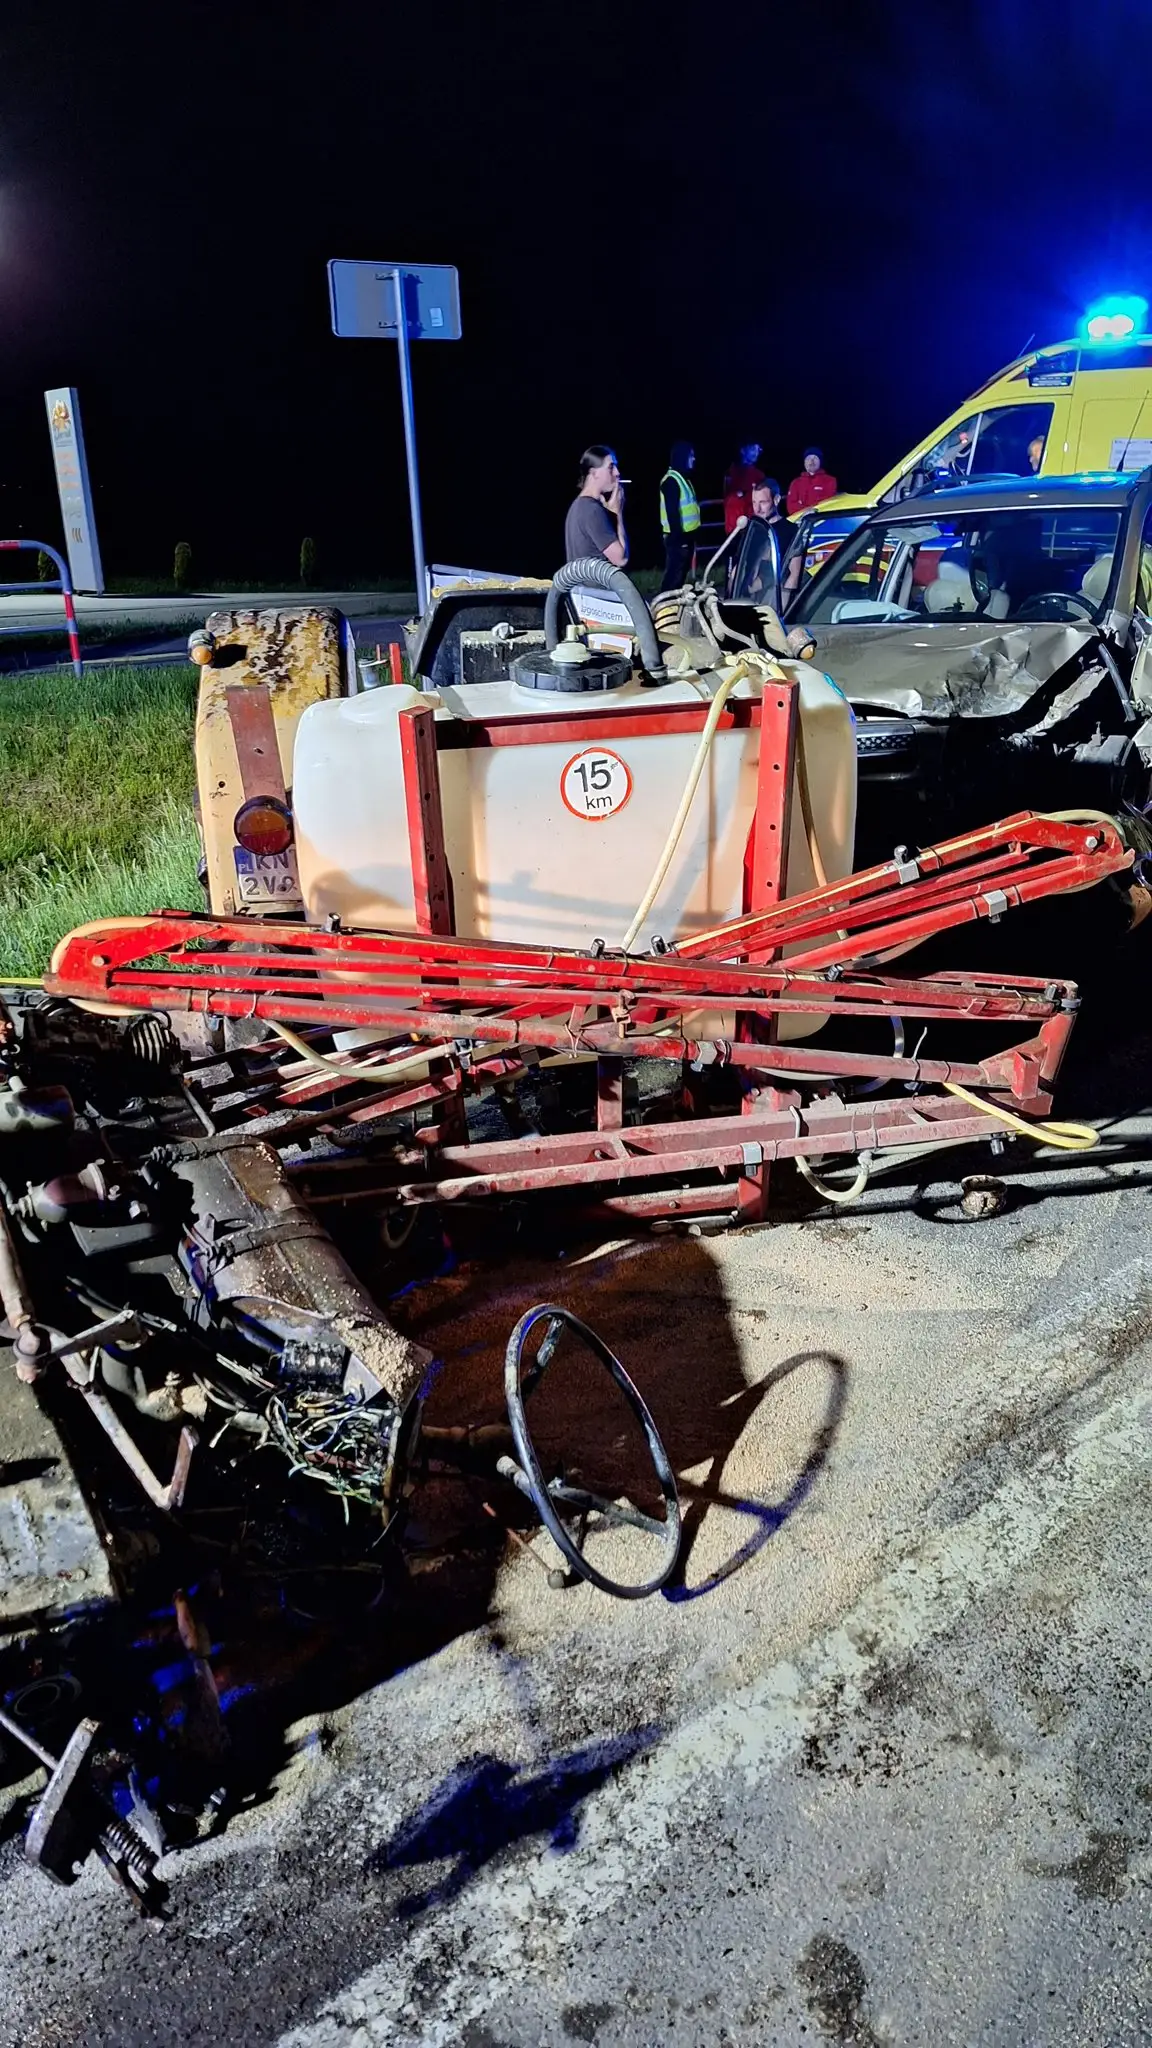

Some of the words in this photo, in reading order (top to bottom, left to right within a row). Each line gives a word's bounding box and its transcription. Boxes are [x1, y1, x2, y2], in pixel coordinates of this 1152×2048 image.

[573, 759, 612, 793] 15
[585, 795, 613, 810] km
[238, 863, 253, 872] PL
